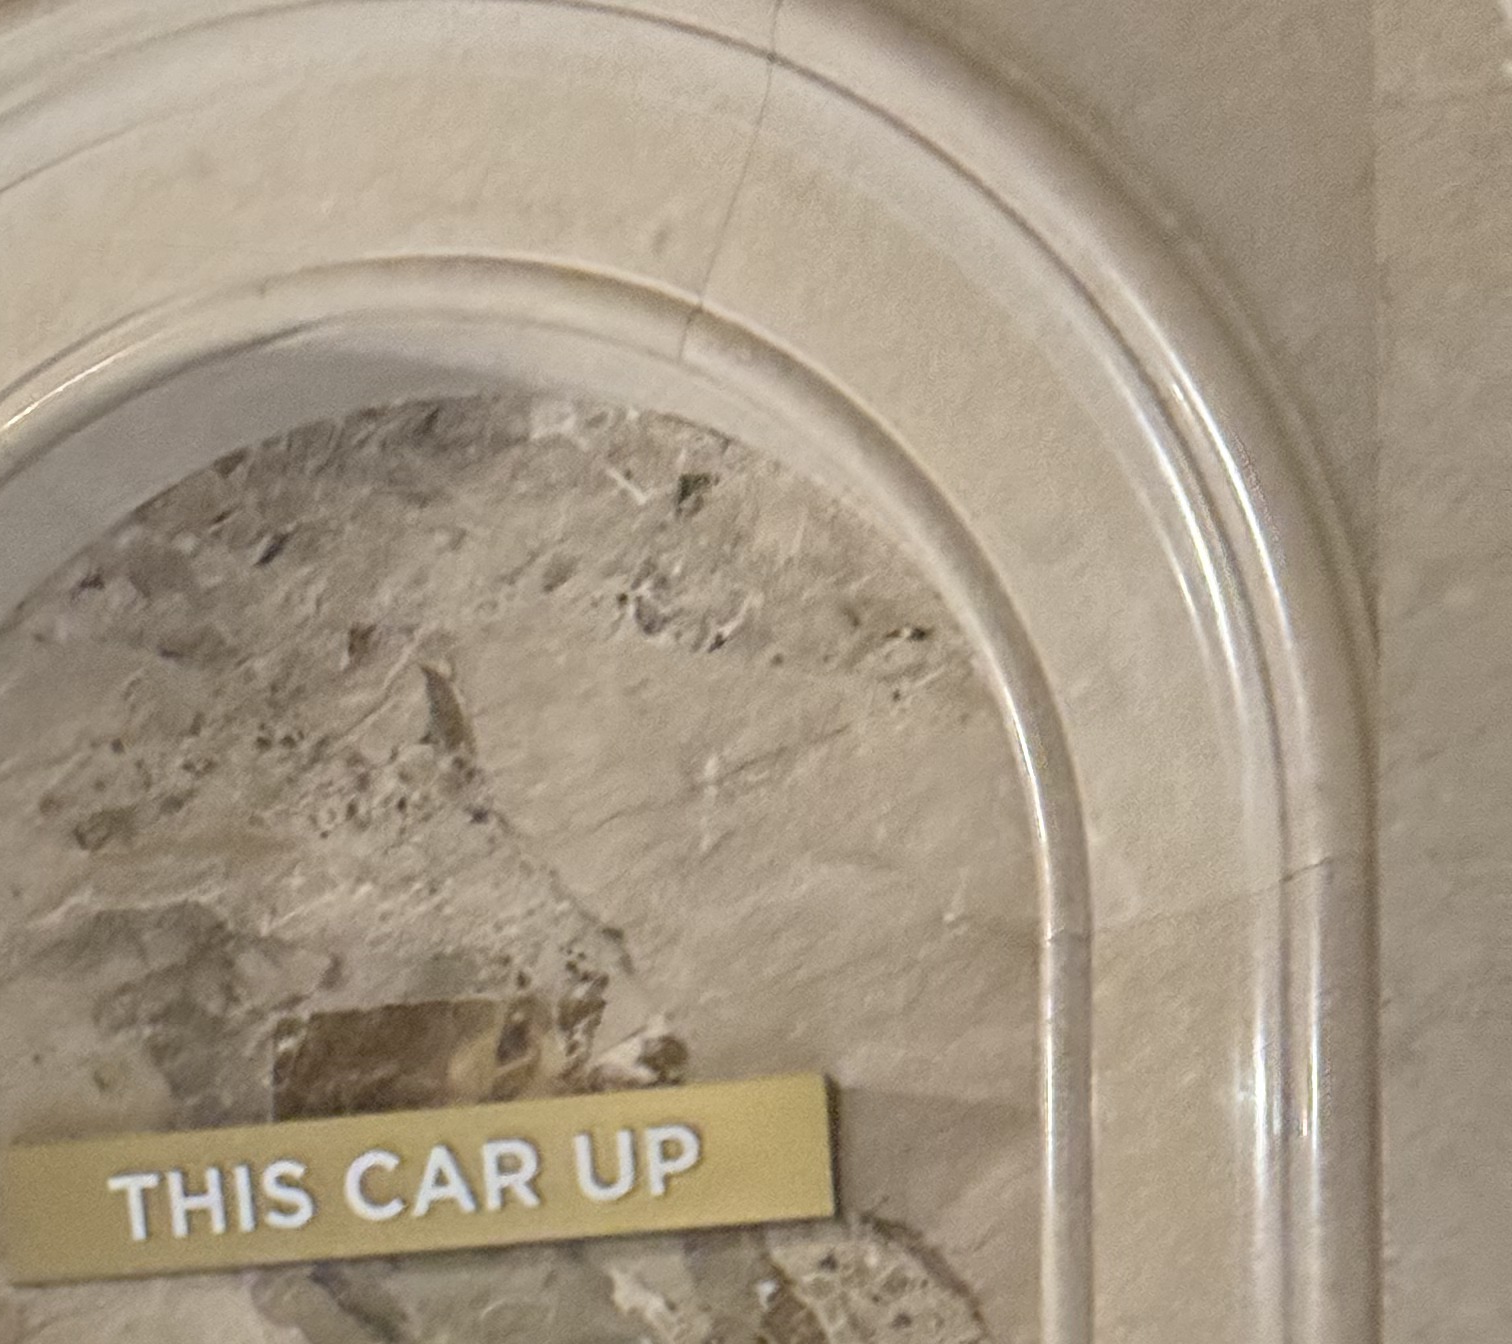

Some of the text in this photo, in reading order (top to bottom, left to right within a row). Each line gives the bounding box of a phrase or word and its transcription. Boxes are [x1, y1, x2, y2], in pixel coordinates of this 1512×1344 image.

[107, 1124, 701, 1242] THIS CAR UP
